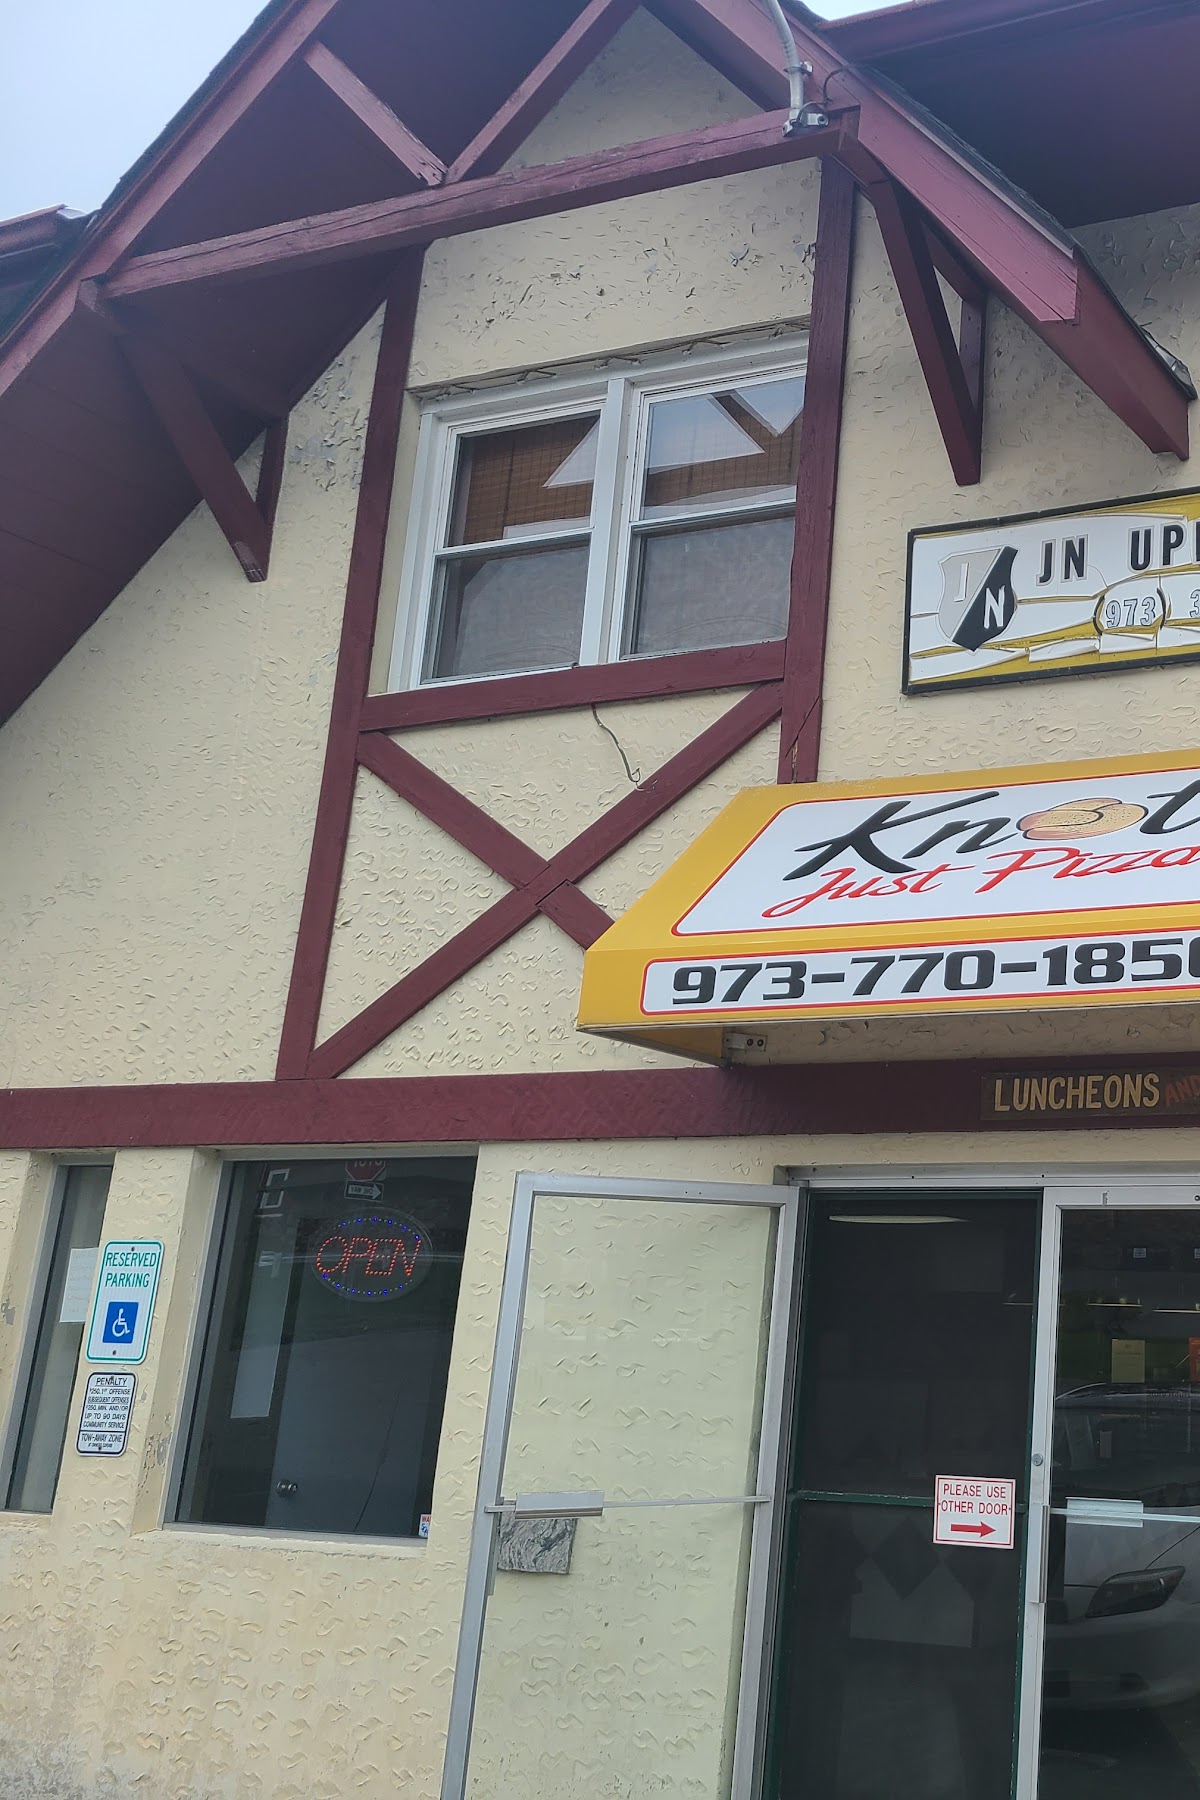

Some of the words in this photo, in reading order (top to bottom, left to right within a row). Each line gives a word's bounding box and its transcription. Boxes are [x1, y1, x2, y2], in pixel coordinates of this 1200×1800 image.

[1037, 535, 1087, 585] JN
[762, 864, 977, 918] Just
[994, 1073, 1160, 1112] LUNCHEONS
[105, 1252, 157, 1267] RESERVED
[316, 1236, 422, 1277] OPEN
[105, 1273, 150, 1288] PARKING
[96, 1377, 128, 1386] PENALTY
[94, 1412, 101, 1420] TO
[943, 1483, 982, 1497] PLEASE
[986, 1486, 1006, 1499] USE
[941, 1500, 974, 1513] OTHER
[978, 1502, 1008, 1516] DOOR
